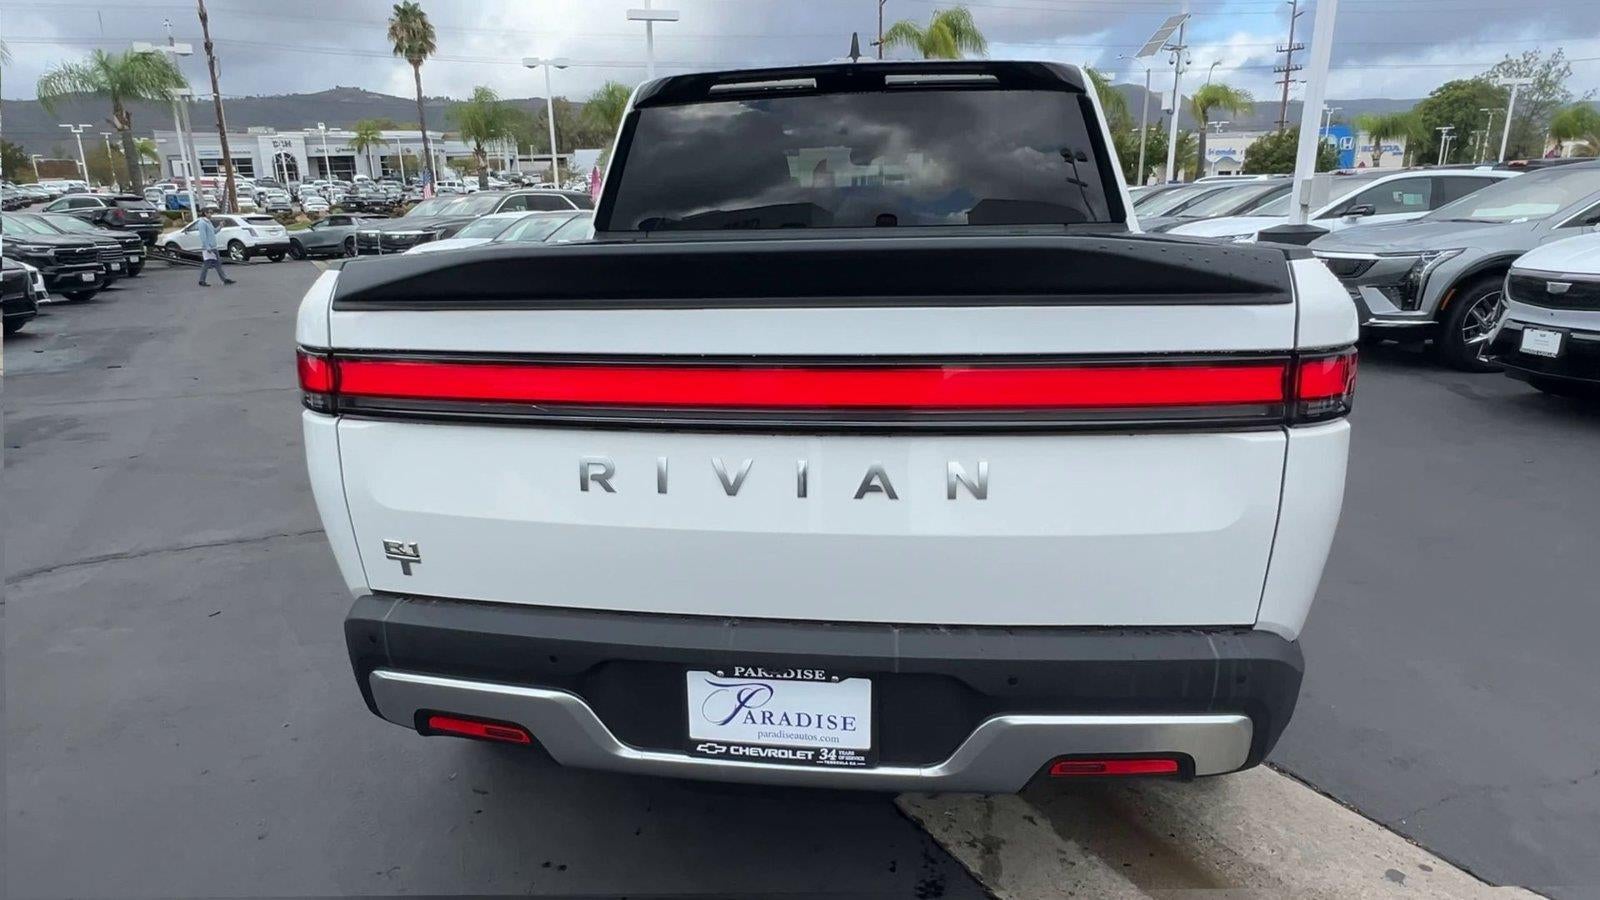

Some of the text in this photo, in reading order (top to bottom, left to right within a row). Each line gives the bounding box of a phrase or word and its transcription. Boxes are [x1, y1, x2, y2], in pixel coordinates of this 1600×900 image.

[579, 456, 989, 501] RIVIAN
[734, 666, 826, 680] PARDISE
[702, 678, 857, 732] PARADISE
[757, 729, 840, 744] paradiseautos.com
[730, 745, 815, 760] CHEVROLET
[819, 748, 838, 761] 34
